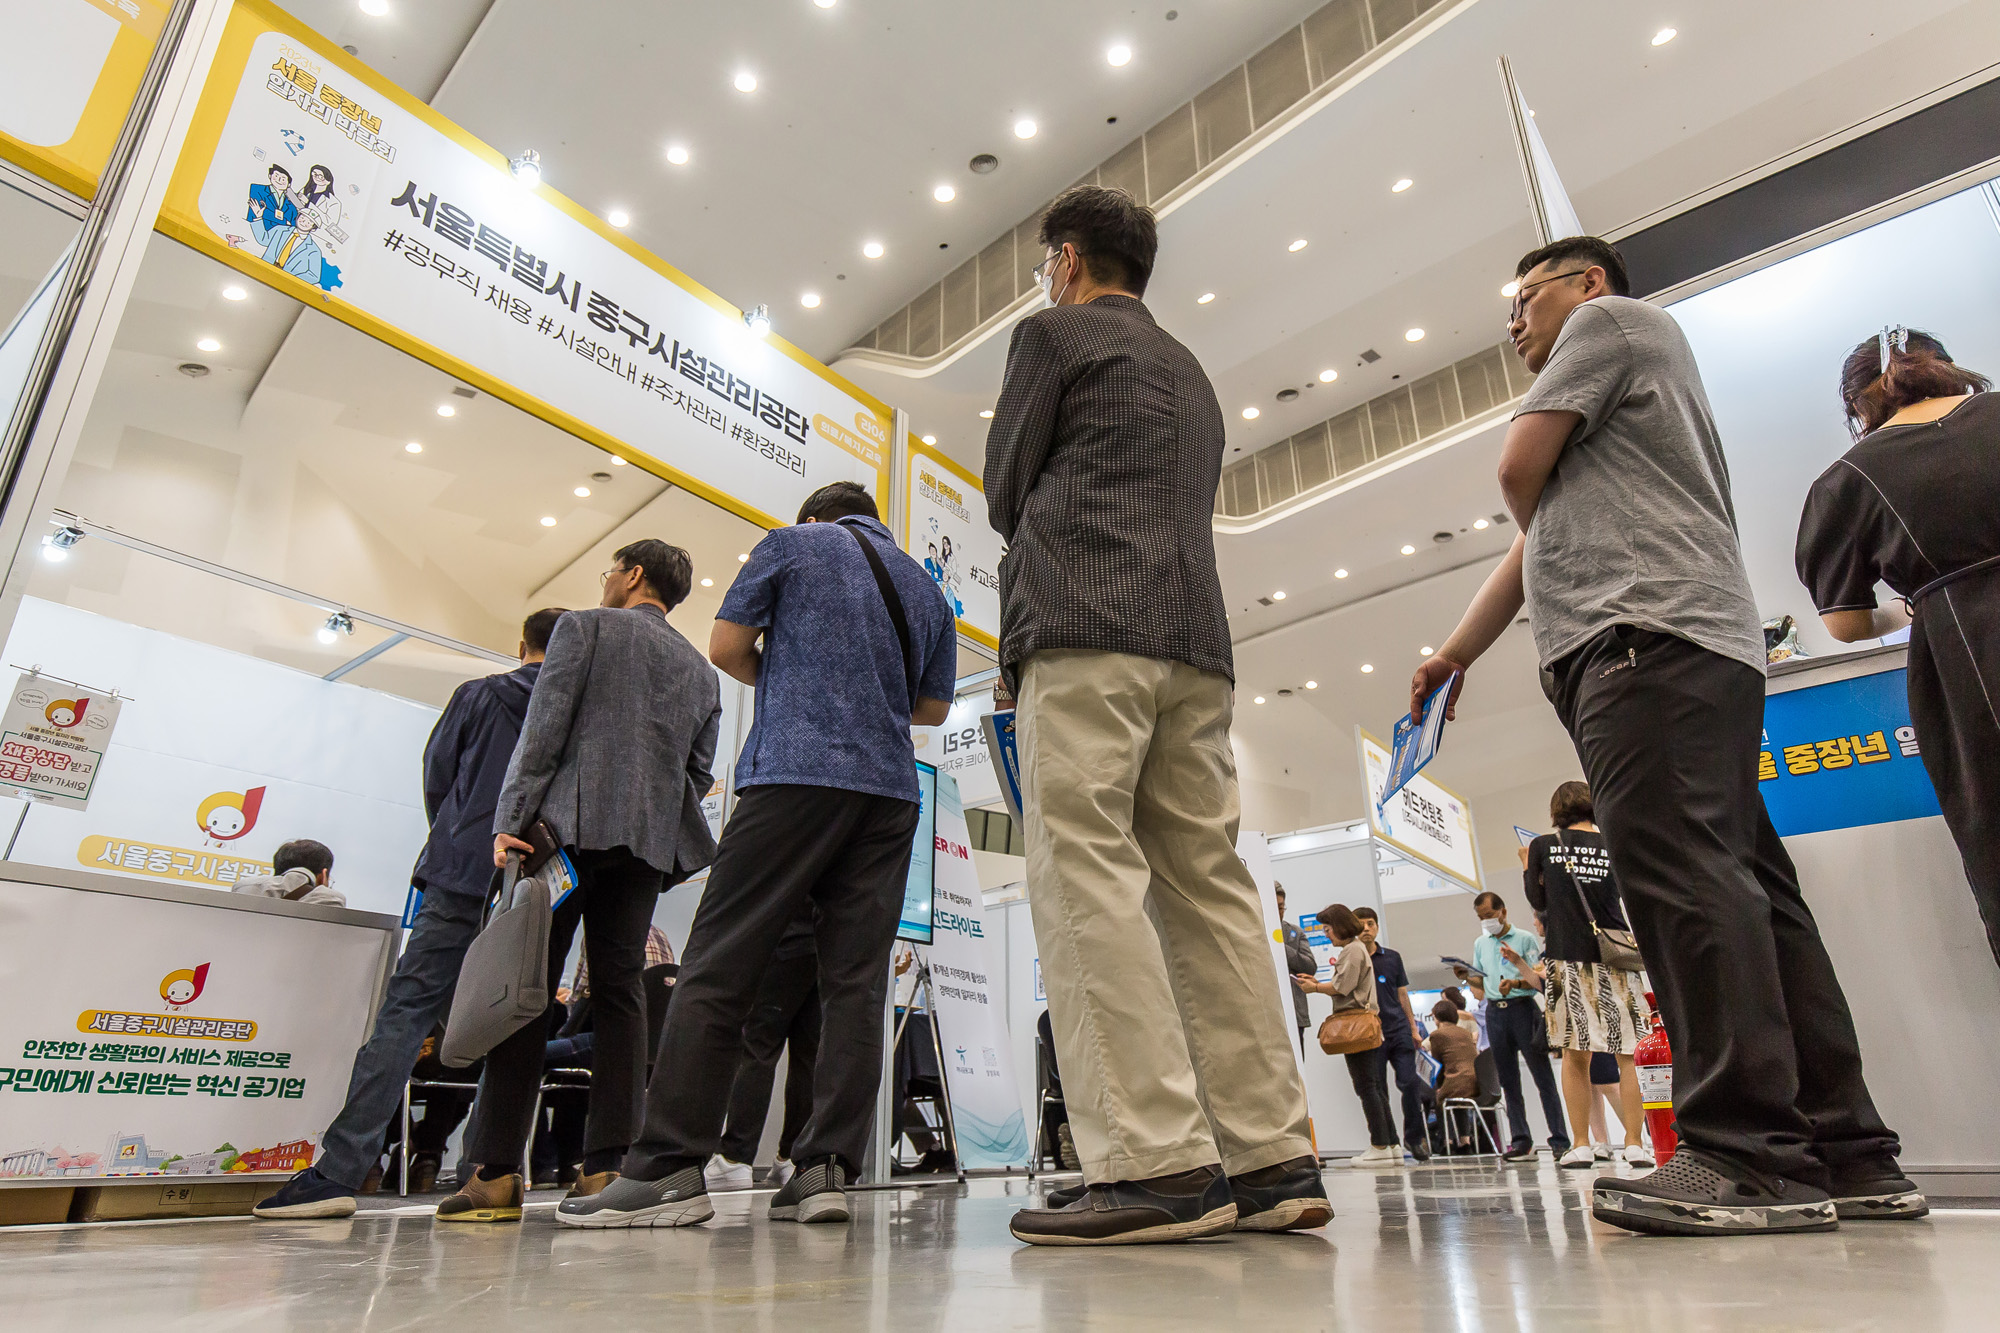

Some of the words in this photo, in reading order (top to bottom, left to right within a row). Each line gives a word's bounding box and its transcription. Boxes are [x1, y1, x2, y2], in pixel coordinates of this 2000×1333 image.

[279, 43, 321, 76] 2023년
[272, 57, 318, 95] 서울
[319, 84, 382, 135] 중장년
[266, 73, 333, 125] 일자리
[335, 113, 397, 164] 박람회
[390, 180, 582, 313] 서울특별시
[586, 290, 810, 445] 중구시설관리공단
[383, 229, 481, 297] #공무직
[484, 284, 533, 325] 채용
[536, 315, 637, 384] #시설안내
[640, 373, 727, 434] #주차관리
[730, 422, 807, 478] #환경관리
[919, 482, 945, 508] 일자리
[945, 498, 970, 523] 박람회
[920, 470, 936, 490] 서울
[937, 480, 963, 506] 중장년
[2, 741, 71, 771] 채용상담
[70, 761, 92, 774] 받고
[19, 731, 89, 753] 서울중구시설관리공단
[1783, 730, 1892, 775] 중장년
[1573, 846, 1597, 855] YOU
[89, 1012, 253, 1040] 서울중구시설관리공단
[23, 1040, 87, 1060] 안전한
[88, 1042, 166, 1065] 생활편의
[166, 1048, 222, 1067] 서비스
[224, 1049, 292, 1070] 제공으로
[0, 1067, 95, 1094] 구민에게
[97, 1071, 192, 1097] 신뢰받는
[196, 1073, 241, 1099] 혁신
[242, 1076, 306, 1100] 공기업
